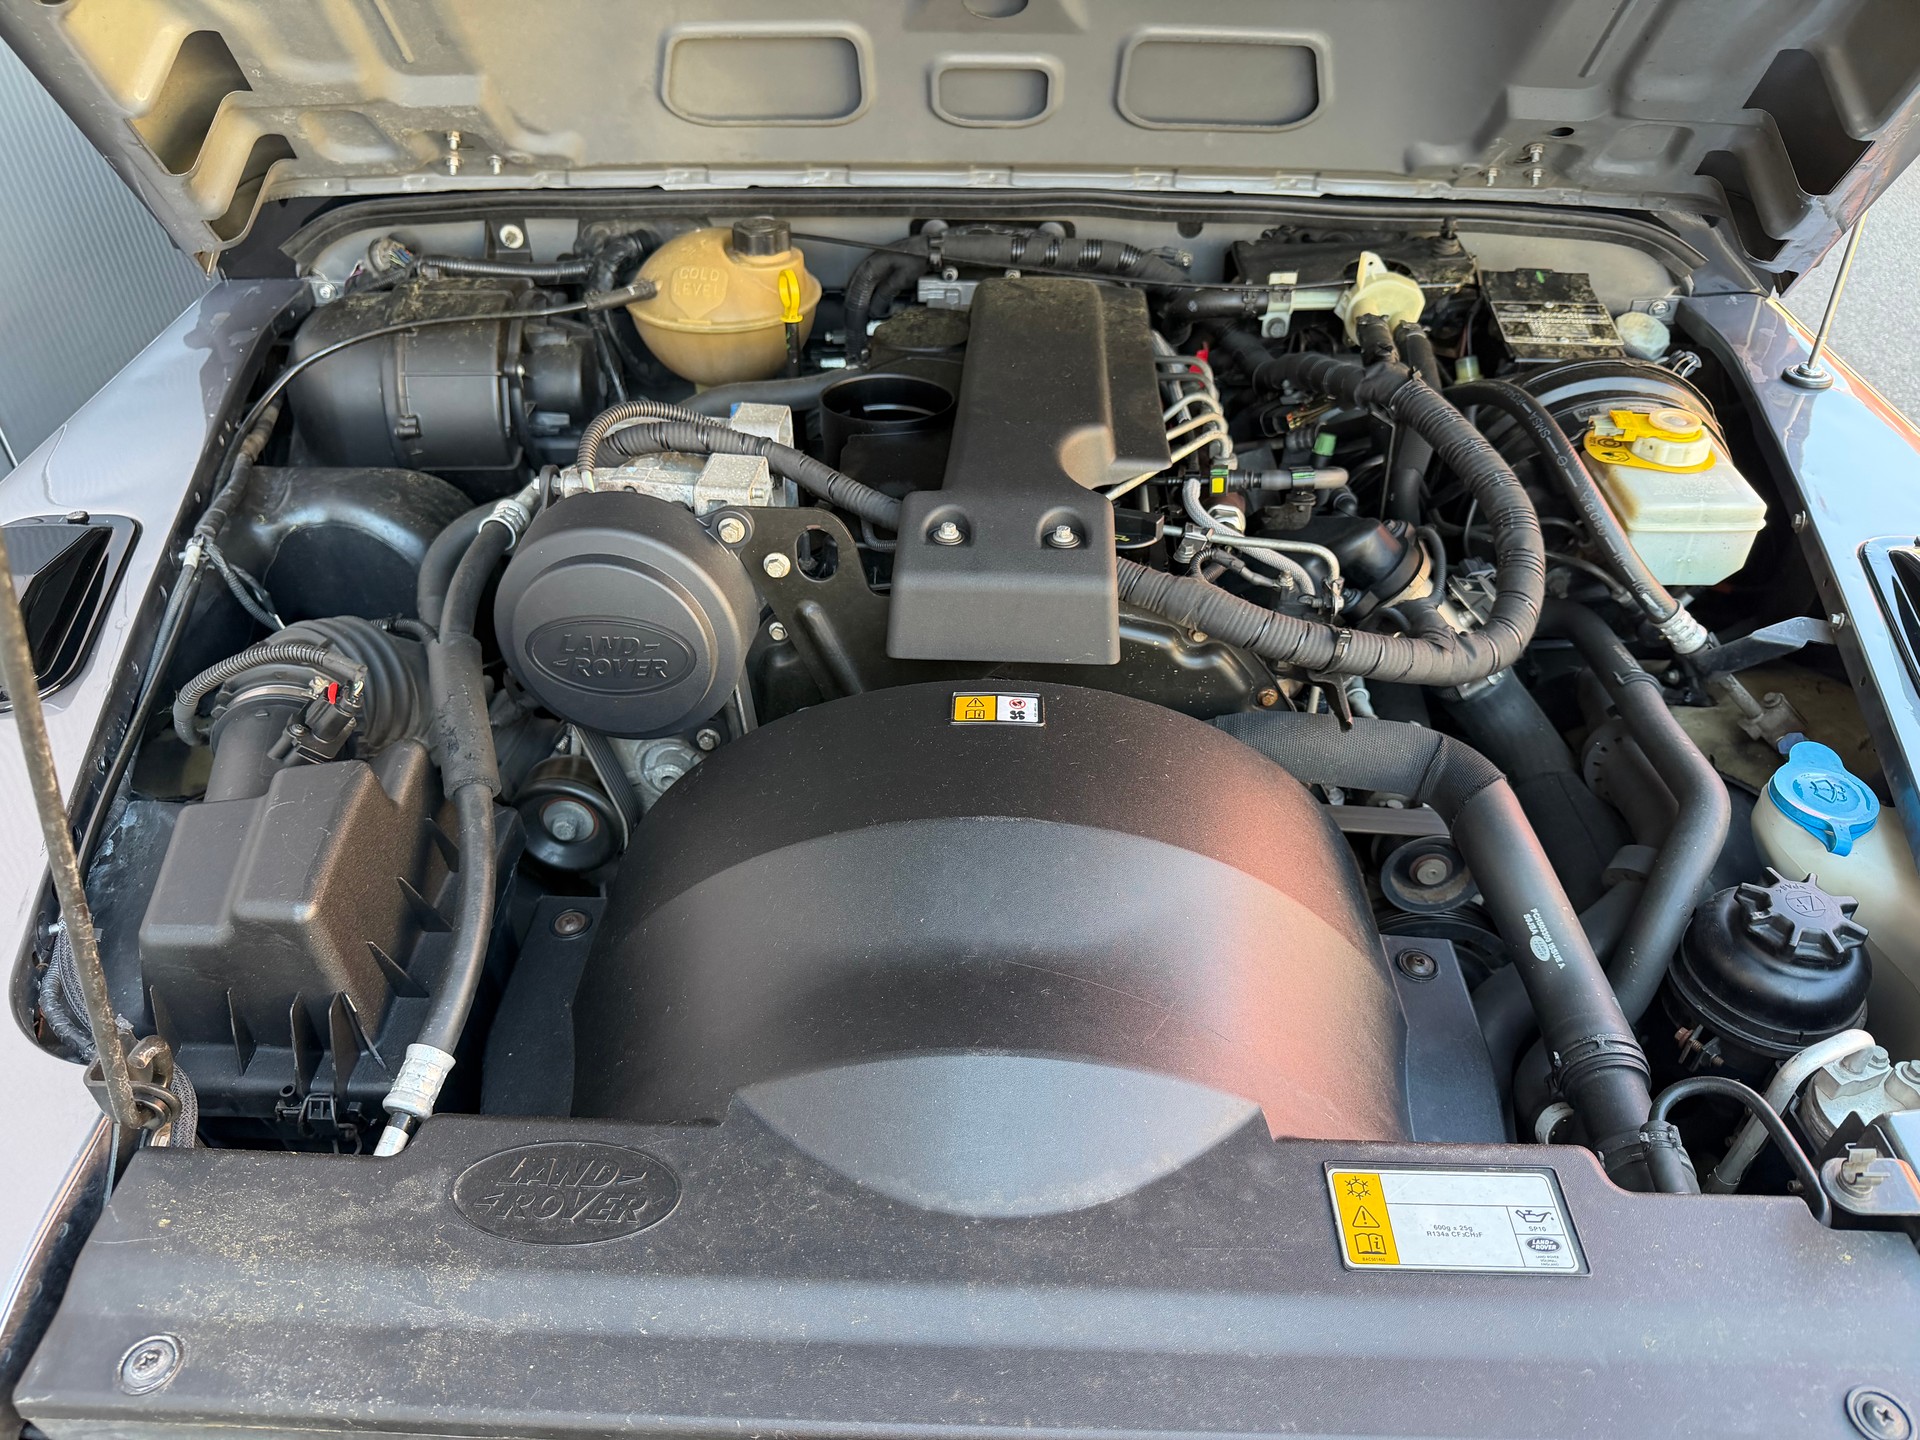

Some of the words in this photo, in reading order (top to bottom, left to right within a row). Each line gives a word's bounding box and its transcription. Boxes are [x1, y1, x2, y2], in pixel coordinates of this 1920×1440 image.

[679, 267, 720, 281] COLD
[673, 283, 720, 297] LEVEL
[1527, 411, 1552, 438] SMSA
[558, 633, 641, 655] LAND
[571, 656, 669, 678] ROVER
[498, 1157, 622, 1187] LAND
[496, 1191, 649, 1223] ROVER
